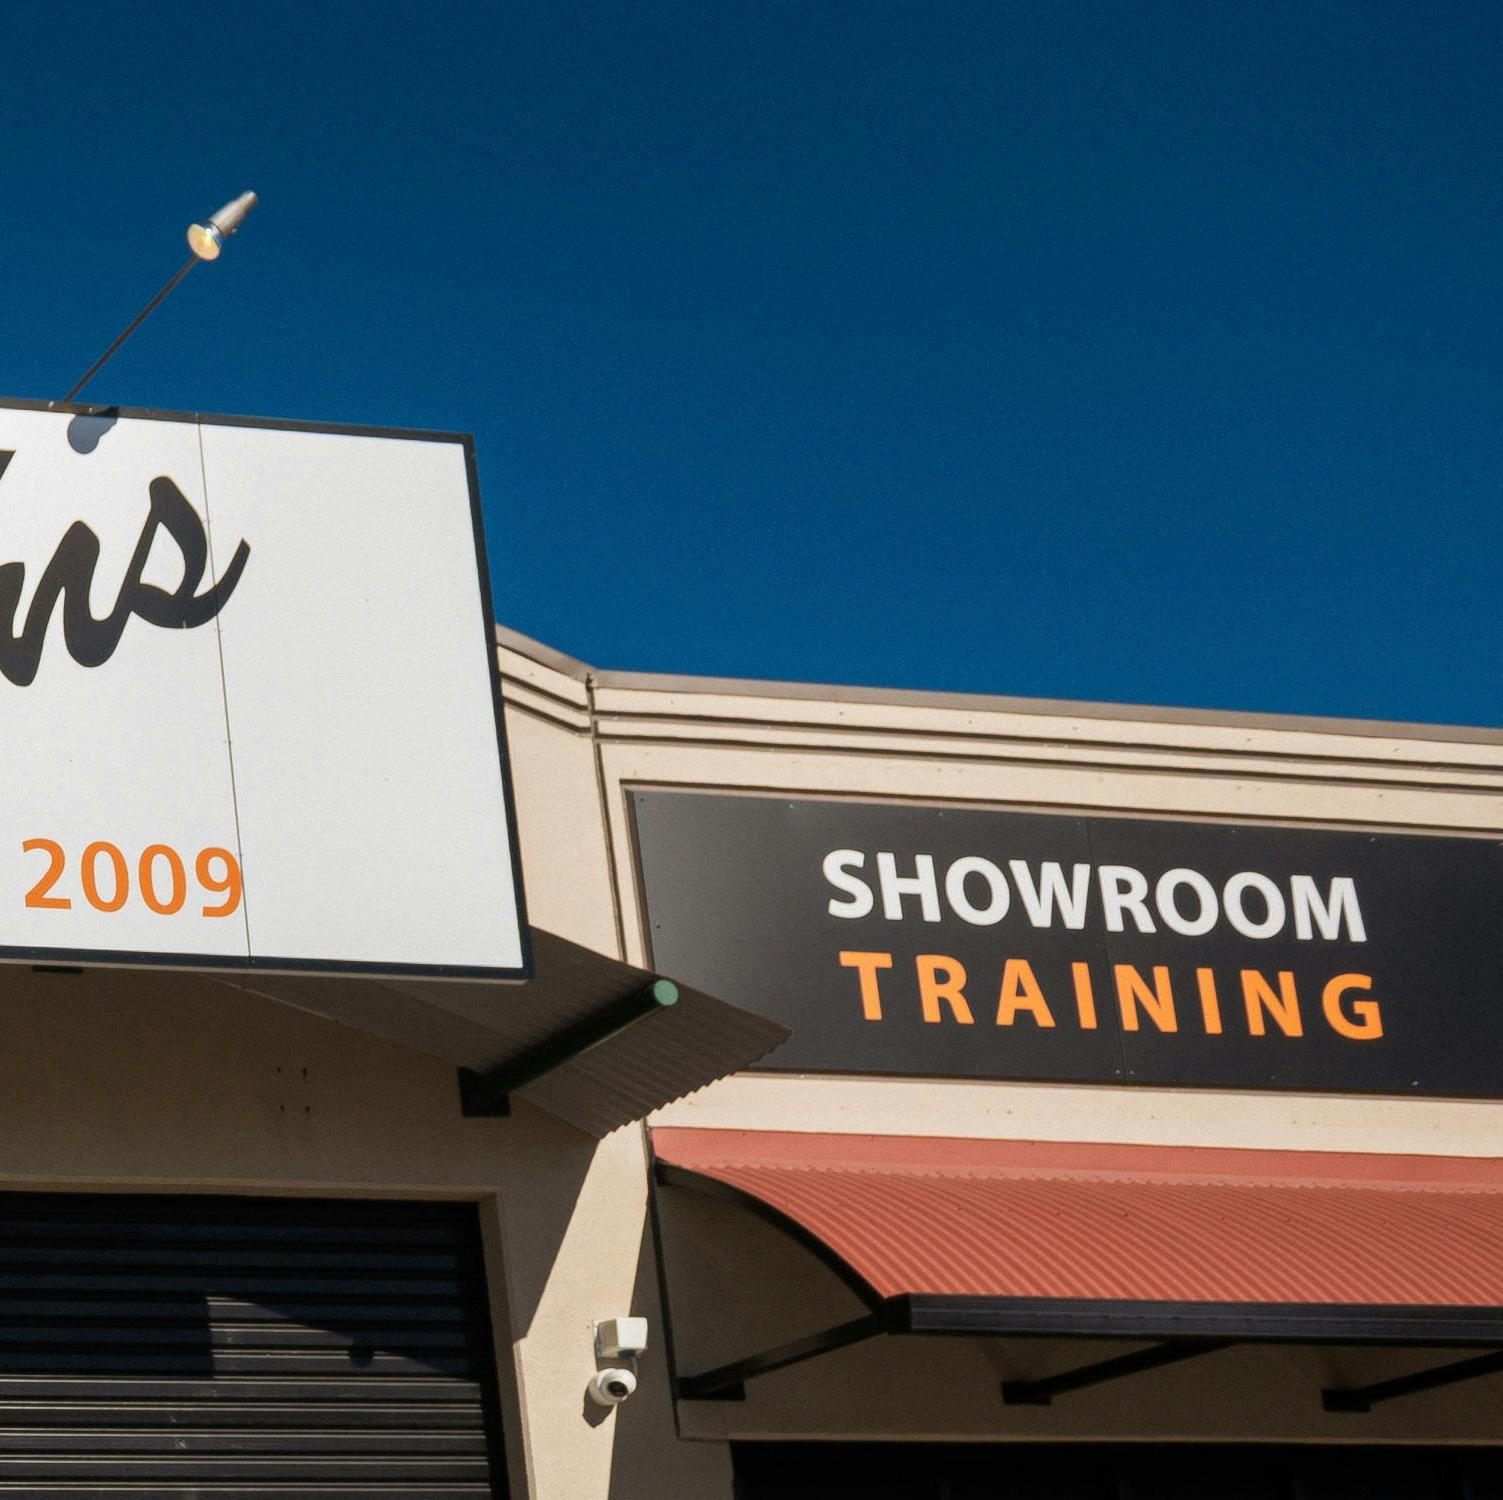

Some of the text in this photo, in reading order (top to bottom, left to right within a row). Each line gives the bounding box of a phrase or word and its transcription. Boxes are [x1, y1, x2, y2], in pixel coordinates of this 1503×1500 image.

[22, 837, 244, 919] 2009
[821, 848, 1368, 944] SHOWROOM
[837, 949, 1385, 1041] TRAINING
